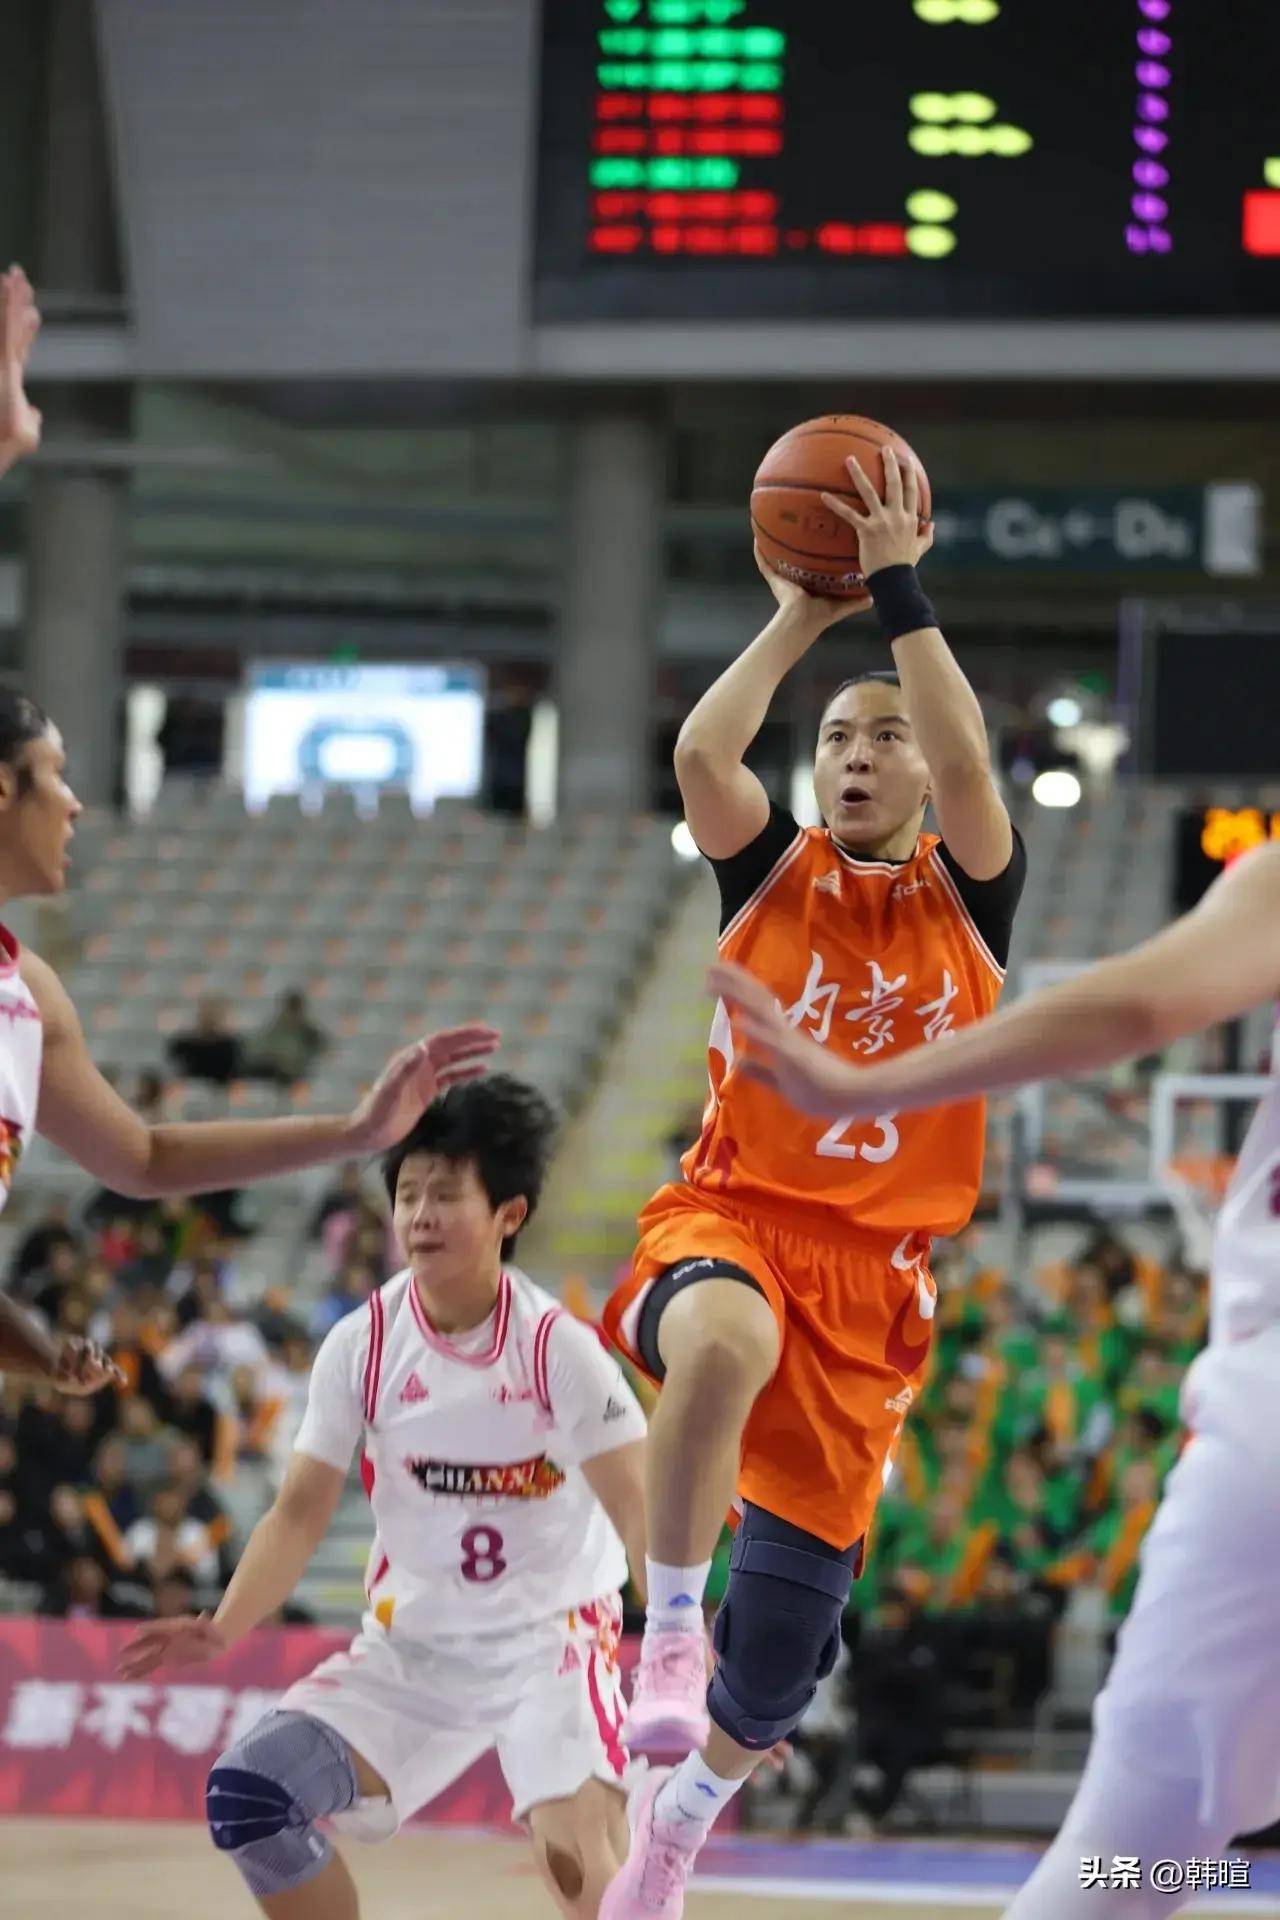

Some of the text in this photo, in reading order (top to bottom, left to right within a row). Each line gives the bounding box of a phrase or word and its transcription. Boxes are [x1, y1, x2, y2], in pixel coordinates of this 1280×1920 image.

[774, 950, 960, 1055] 内蒙古
[815, 1109, 900, 1163] 23
[460, 1524, 507, 1583] 8
